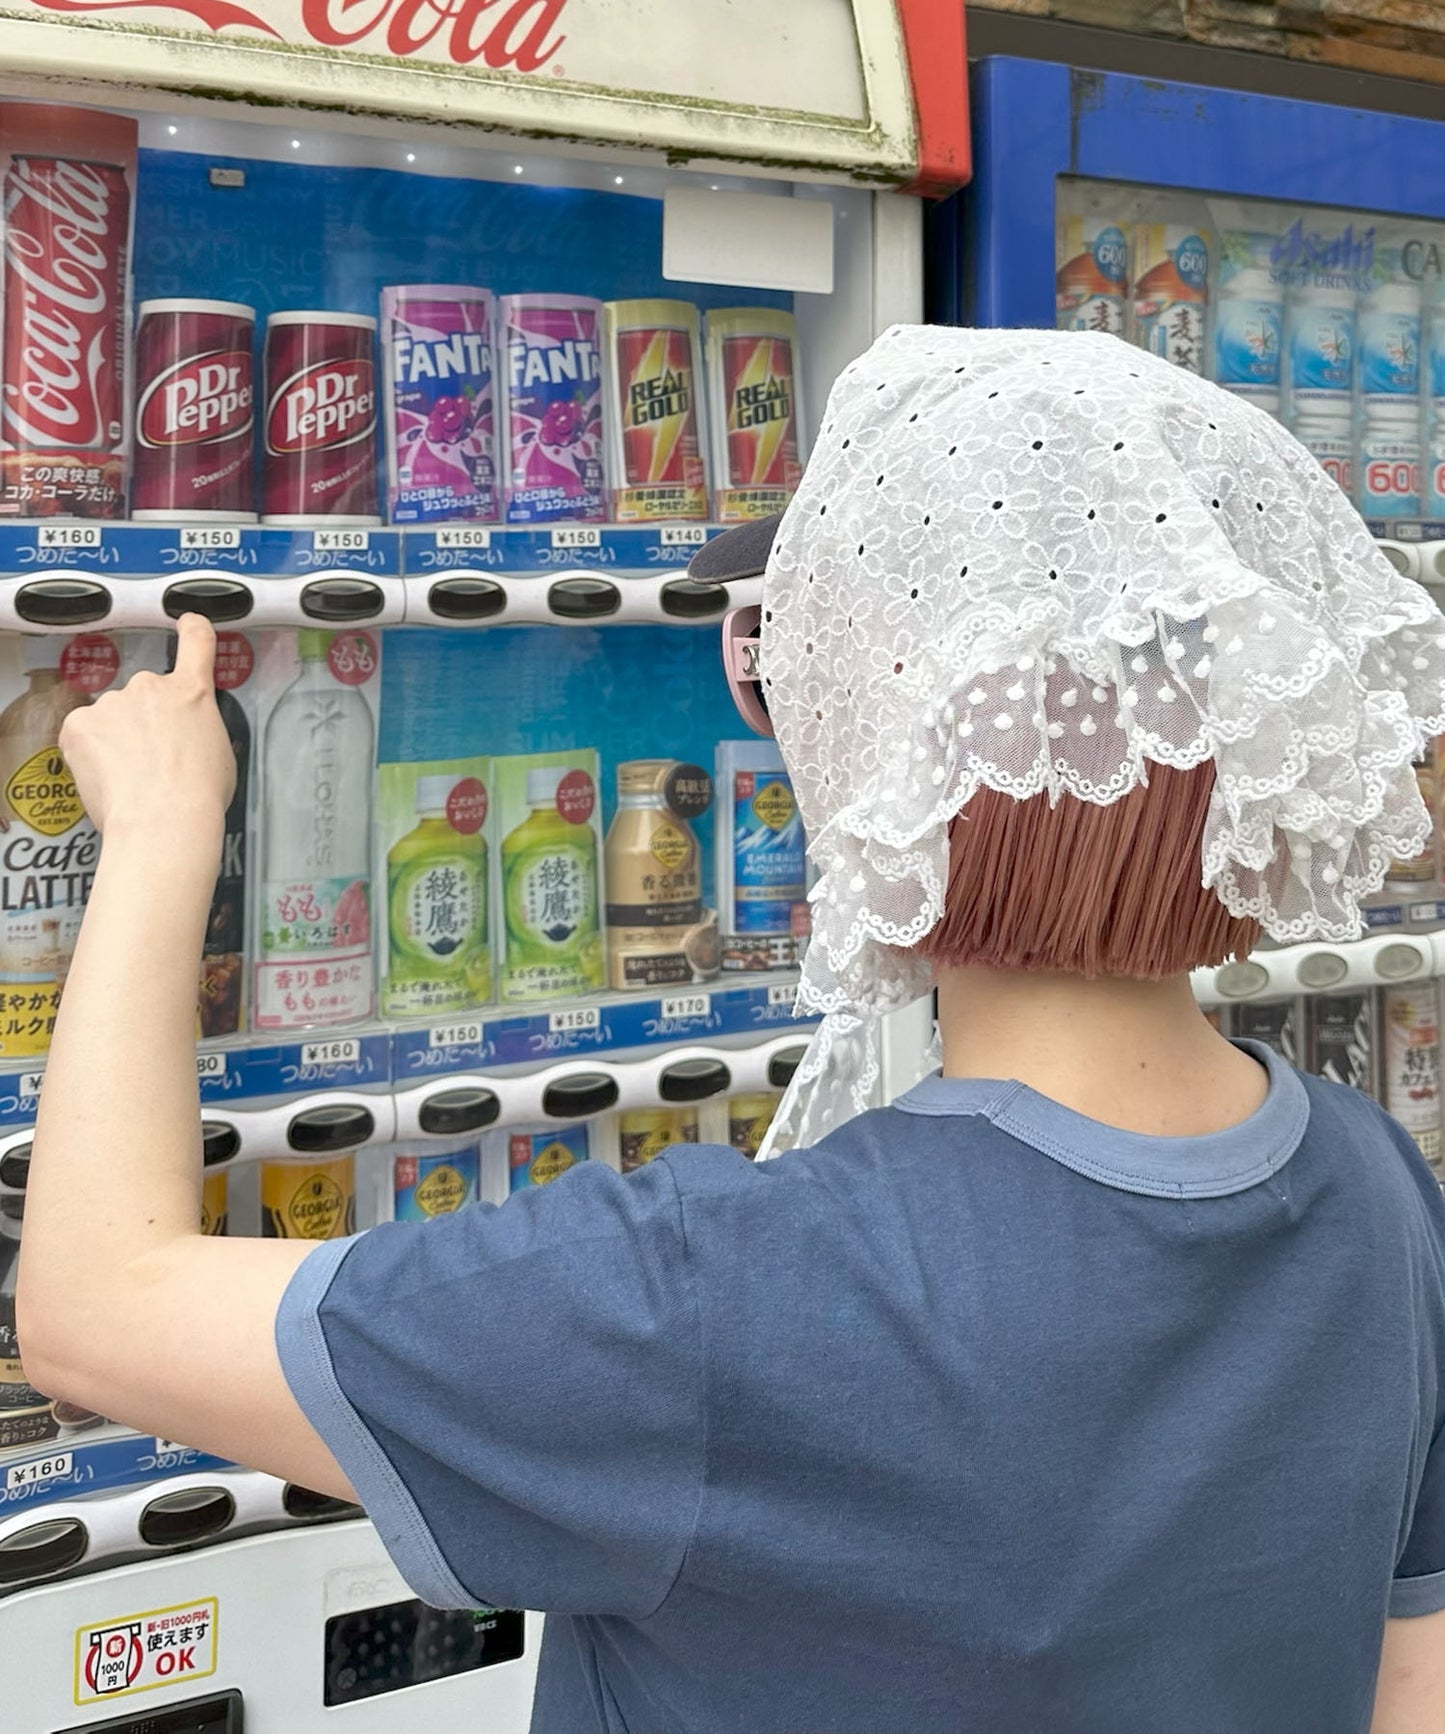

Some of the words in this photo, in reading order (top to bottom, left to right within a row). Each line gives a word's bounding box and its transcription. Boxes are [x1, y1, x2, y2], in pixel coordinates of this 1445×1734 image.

[1270, 218, 1376, 274] Asahi
[199, 363, 240, 400] Dr
[316, 371, 358, 402] Dr
[631, 369, 689, 404] REAL
[736, 374, 789, 407] REAL
[632, 391, 688, 426] GOLD
[737, 399, 789, 429] GOLD
[44, 529, 96, 544] ¥160
[186, 531, 233, 545] ¥150
[320, 533, 363, 546] ¥150
[441, 531, 483, 545] ¥150
[557, 531, 596, 544] ¥150
[665, 529, 701, 542] ¥140
[331, 644, 374, 672] もも
[12, 783, 80, 801] GEORG
[29, 798, 78, 818] Coffee
[4, 830, 97, 871] Café
[539, 857, 571, 923] 綾鷹
[278, 894, 321, 923] もも
[426, 868, 458, 937] 綾鷹
[666, 999, 704, 1013] ¥170
[555, 1012, 596, 1027] ¥150
[435, 1027, 478, 1042] ¥150
[308, 1043, 353, 1060] ¥160
[14, 1458, 65, 1484] ¥160
[147, 1609, 209, 1633] 新・旧1000円札
[107, 1637, 124, 1656] 新
[147, 1623, 209, 1652] 使えます
[102, 1660, 124, 1676] 1000
[155, 1646, 195, 1676] OK
[107, 1675, 118, 1687] 円
